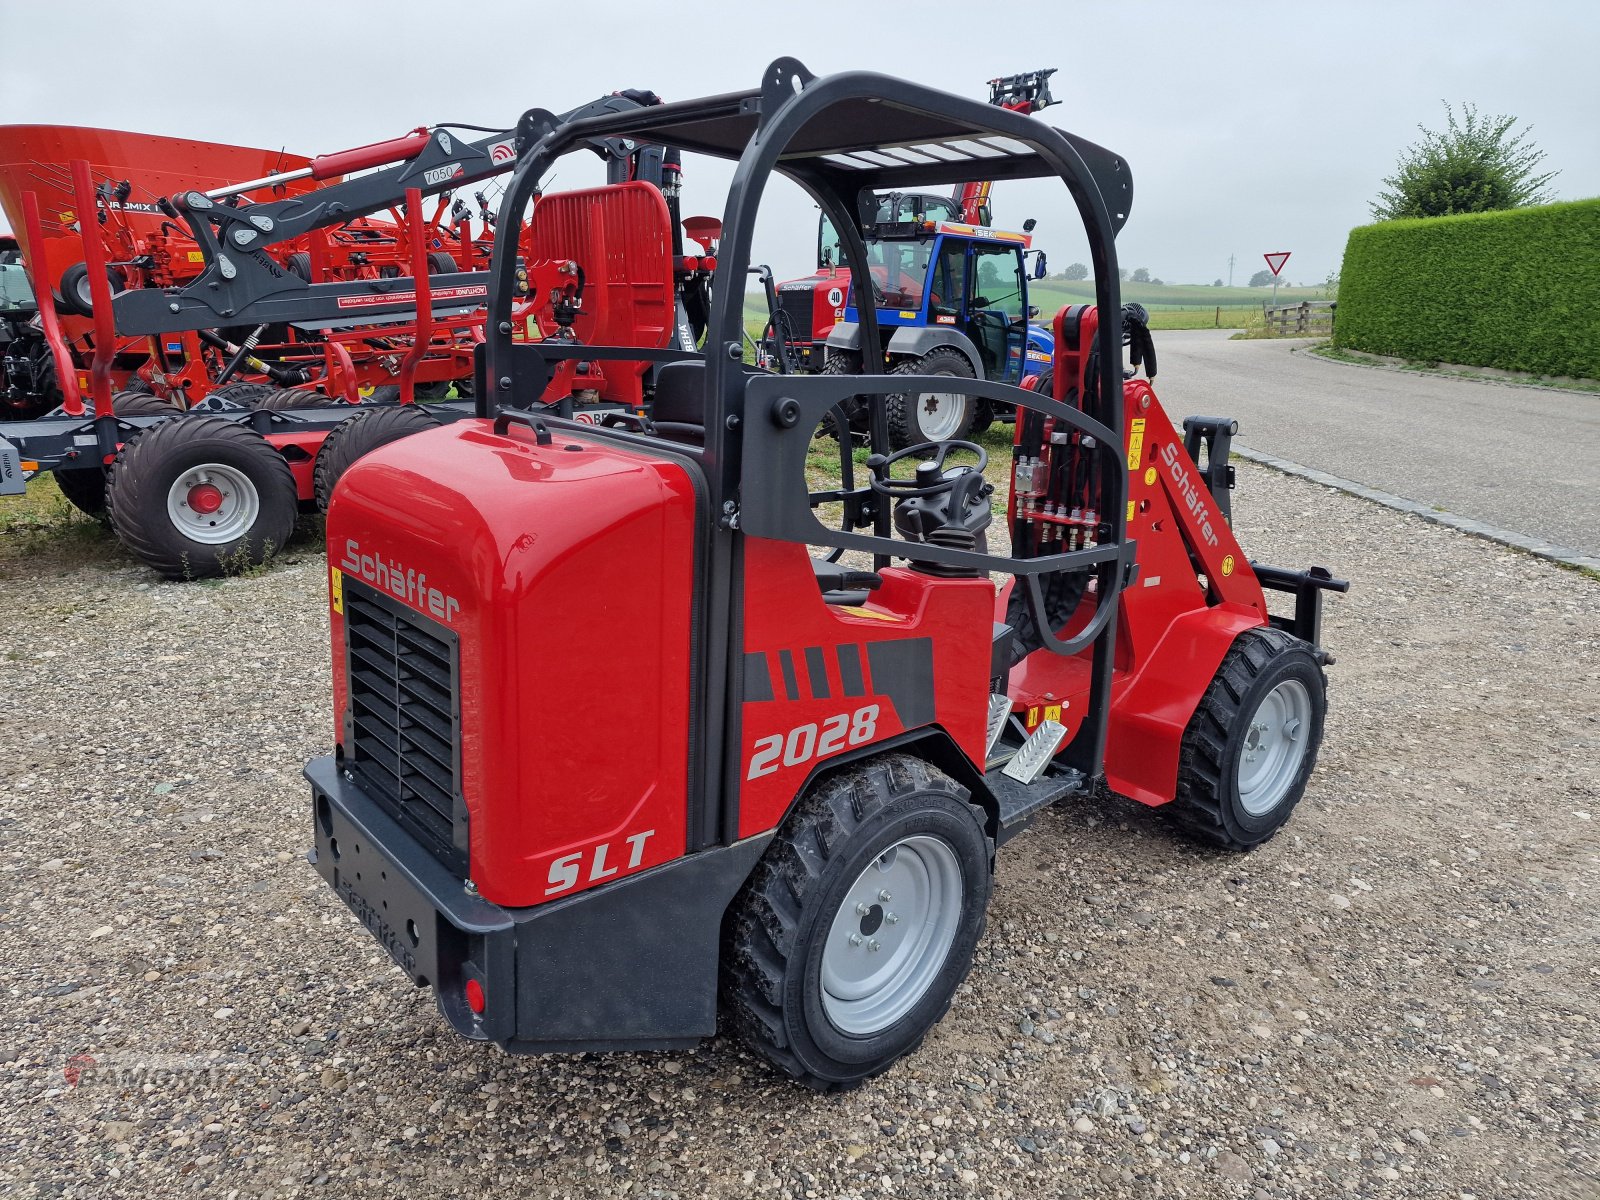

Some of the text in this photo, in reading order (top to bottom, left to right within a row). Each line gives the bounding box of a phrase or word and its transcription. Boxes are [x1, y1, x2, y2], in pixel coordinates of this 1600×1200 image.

[424, 167, 453, 183] 7050
[455, 286, 485, 296] ACHTUNG!
[831, 291, 841, 304] 40
[679, 325, 694, 352] BEHA
[1026, 352, 1043, 361] SEKI
[1161, 443, 1218, 547] Schäffer
[341, 538, 460, 623] Schäffer
[746, 704, 880, 781] 2028
[544, 829, 655, 897] SLT
